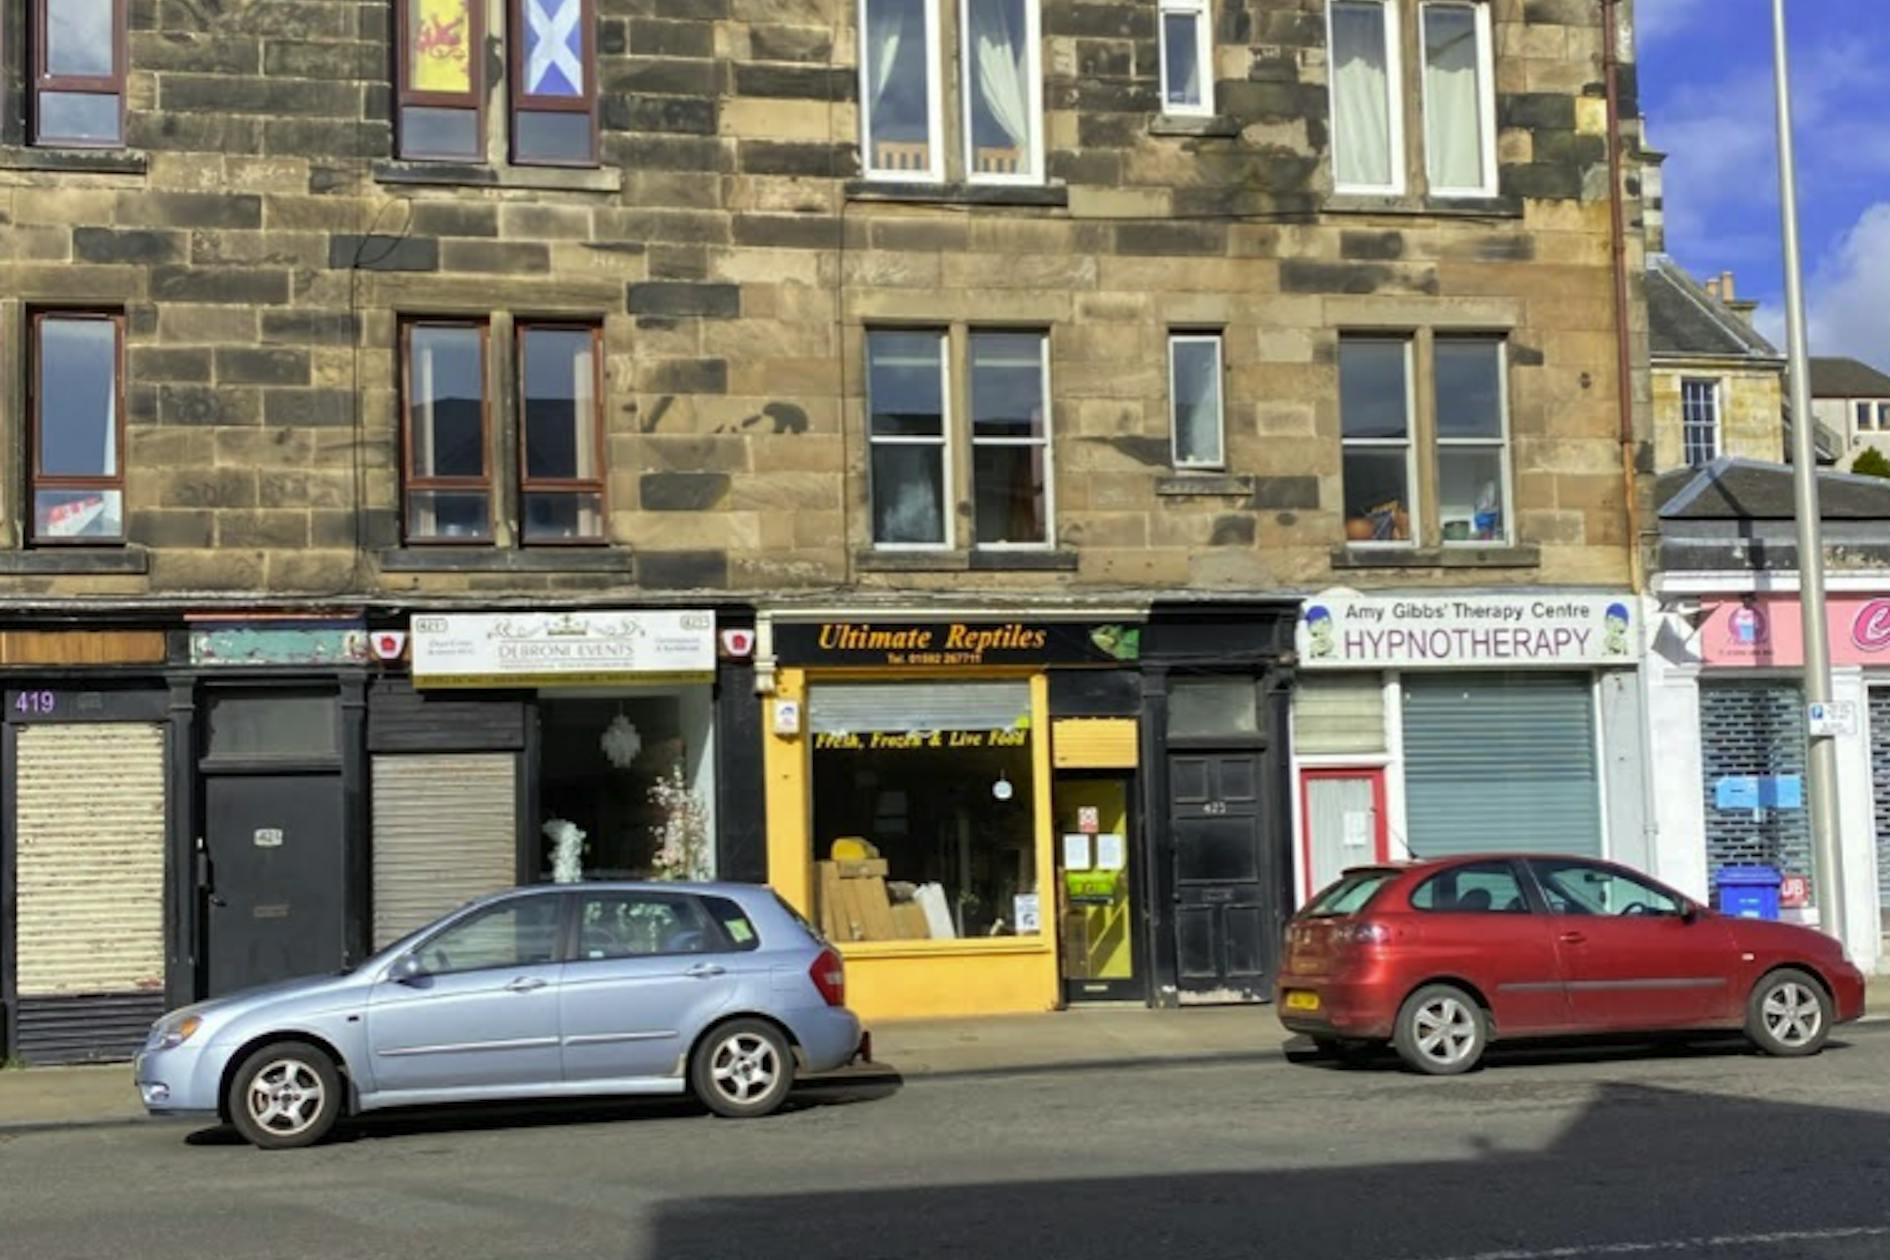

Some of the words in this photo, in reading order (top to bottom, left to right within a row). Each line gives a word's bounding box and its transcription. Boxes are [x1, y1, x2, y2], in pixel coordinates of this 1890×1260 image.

[1346, 604, 1384, 621] Amy
[1393, 603, 1448, 619] Gibbs'
[1454, 603, 1523, 620] Therapy
[1531, 602, 1590, 618] Centre
[819, 624, 932, 649] Ultimate
[945, 624, 1046, 652] Reptiles
[1344, 627, 1592, 659] HYPNOTHERAPY
[577, 642, 634, 657] EVENTS
[15, 691, 55, 713] 419
[950, 731, 981, 746] Live
[988, 730, 1027, 747] Food
